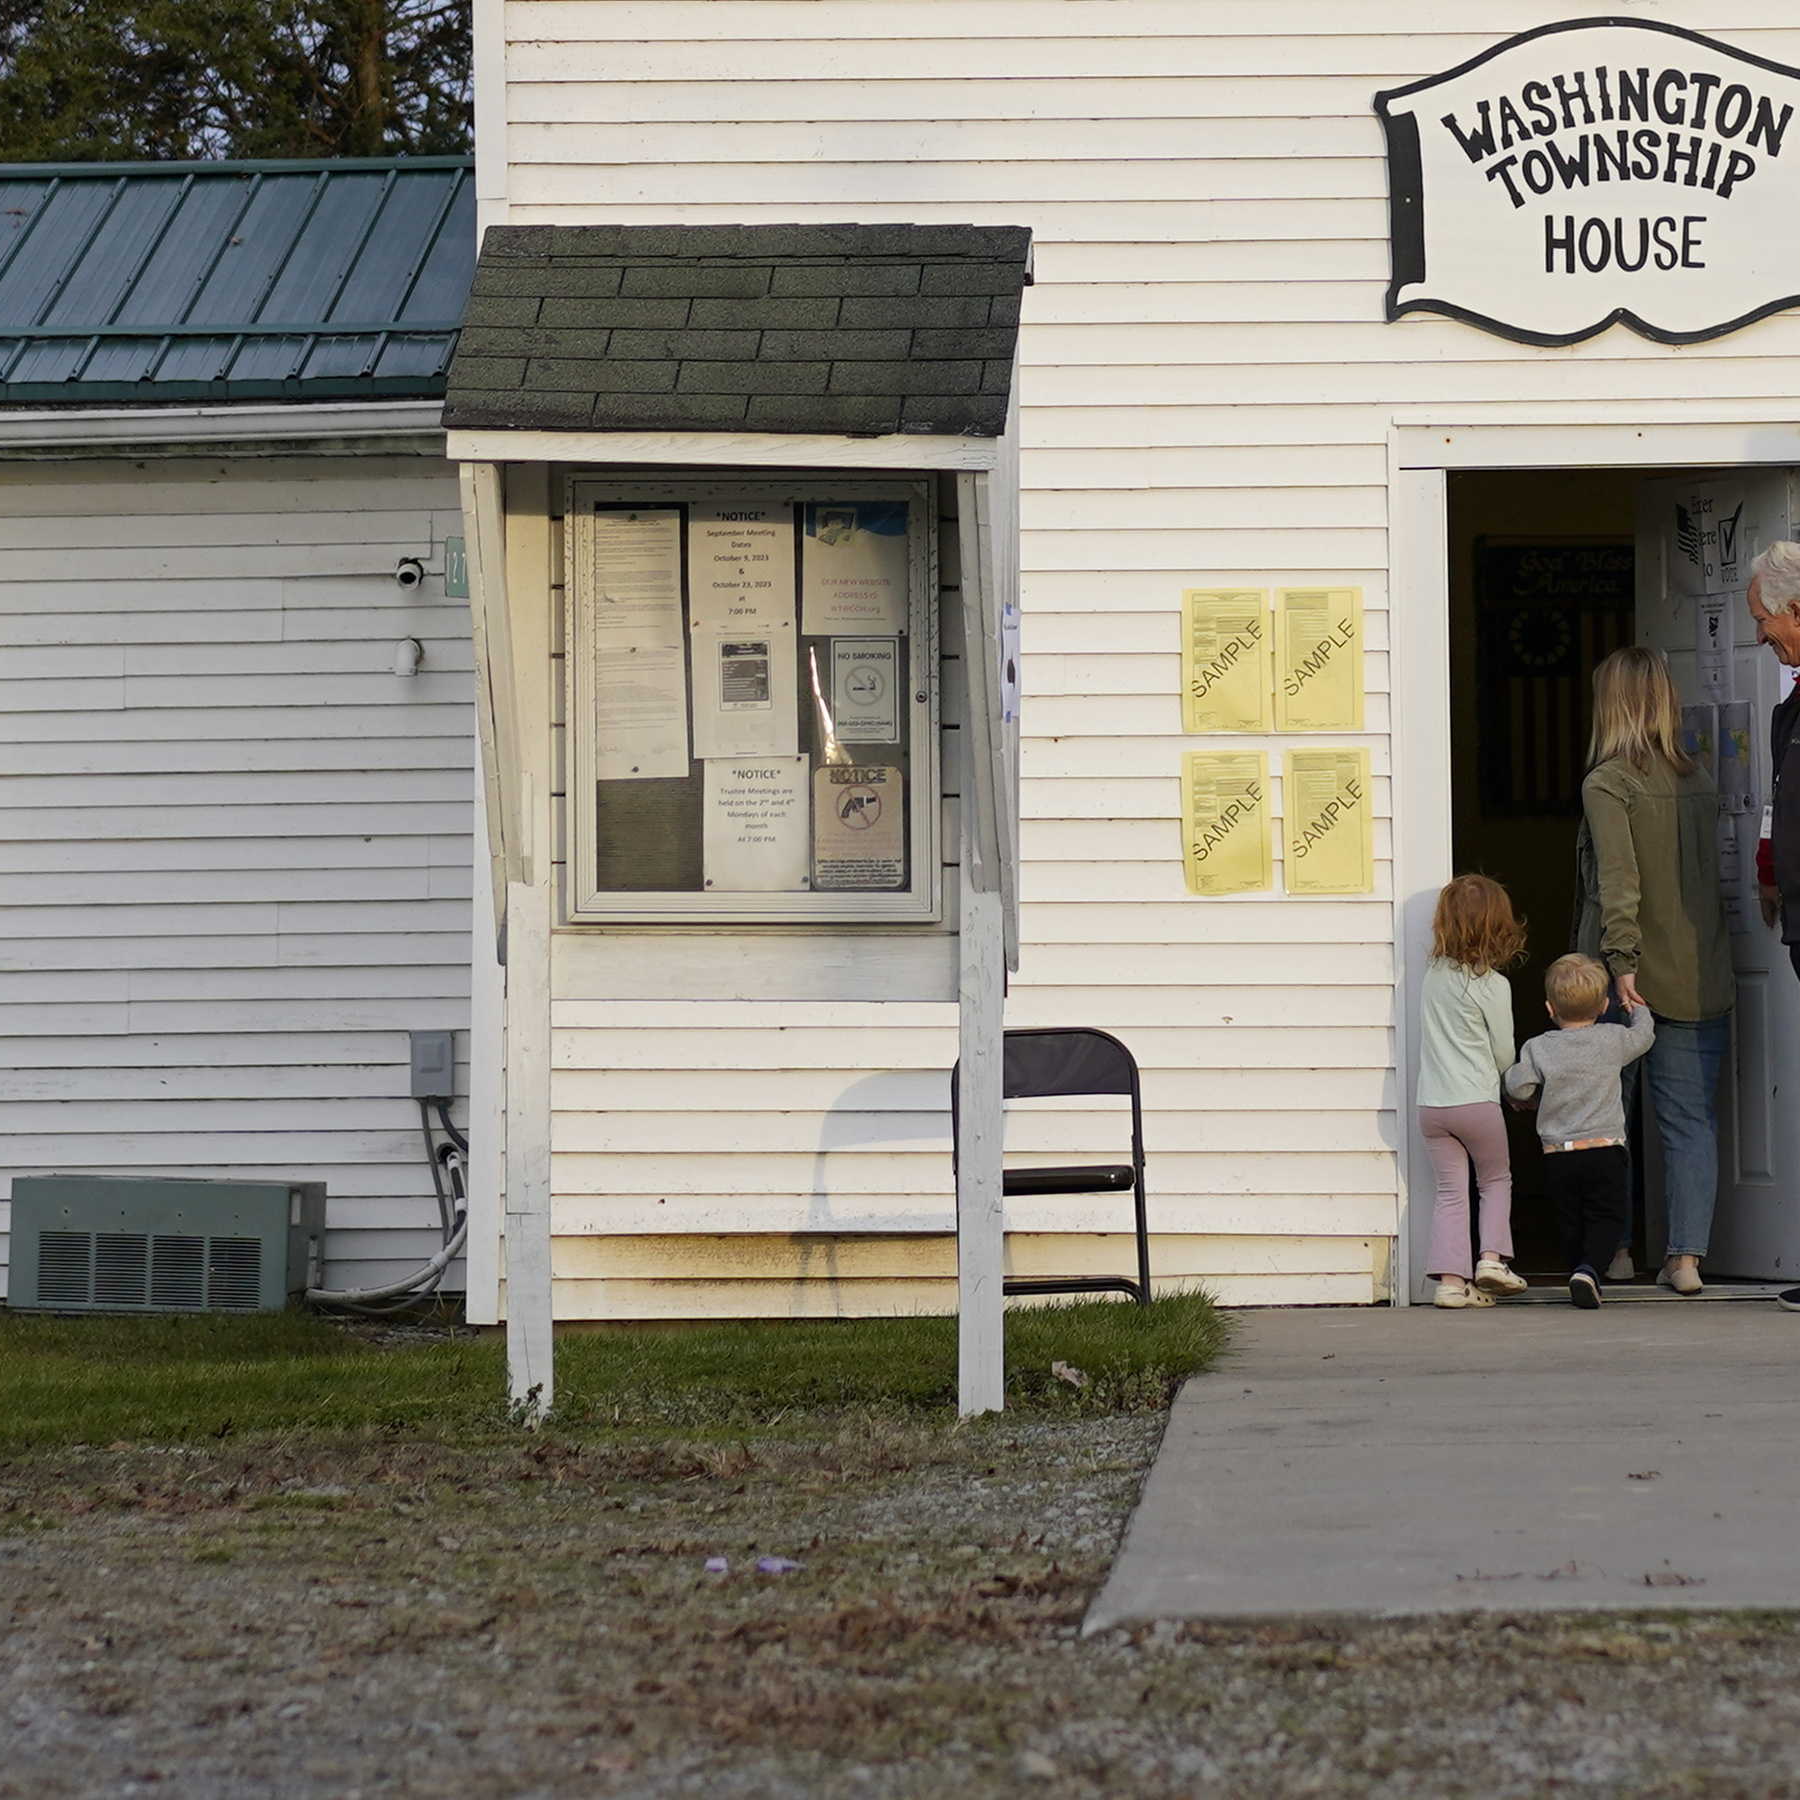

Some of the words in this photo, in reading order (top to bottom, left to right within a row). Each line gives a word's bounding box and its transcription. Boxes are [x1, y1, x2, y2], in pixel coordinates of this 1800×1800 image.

[1441, 65, 1794, 163] WASHINGTON
[1485, 129, 1755, 209] TOWNSHIP
[1544, 215, 1707, 274] HOUSE
[706, 529, 745, 538] September
[746, 529, 776, 537] Meeting
[1698, 528, 1717, 546] ere
[713, 554, 741, 562] October
[1518, 550, 1572, 577] God
[1575, 550, 1634, 571] Bless
[821, 578, 838, 586] OUR
[839, 578, 857, 586] NEW
[858, 578, 891, 586] WEBSITE
[1512, 573, 1621, 595] America
[837, 652, 851, 660] NO
[852, 652, 891, 660] SMOKING
[1190, 618, 1263, 698] SAMPLE
[1283, 617, 1356, 697] SAMPLE
[829, 769, 887, 783] NOTICE
[747, 788, 780, 796] Meetings
[1192, 781, 1264, 862] SAMPLE
[1292, 779, 1364, 860] SAMPLE
